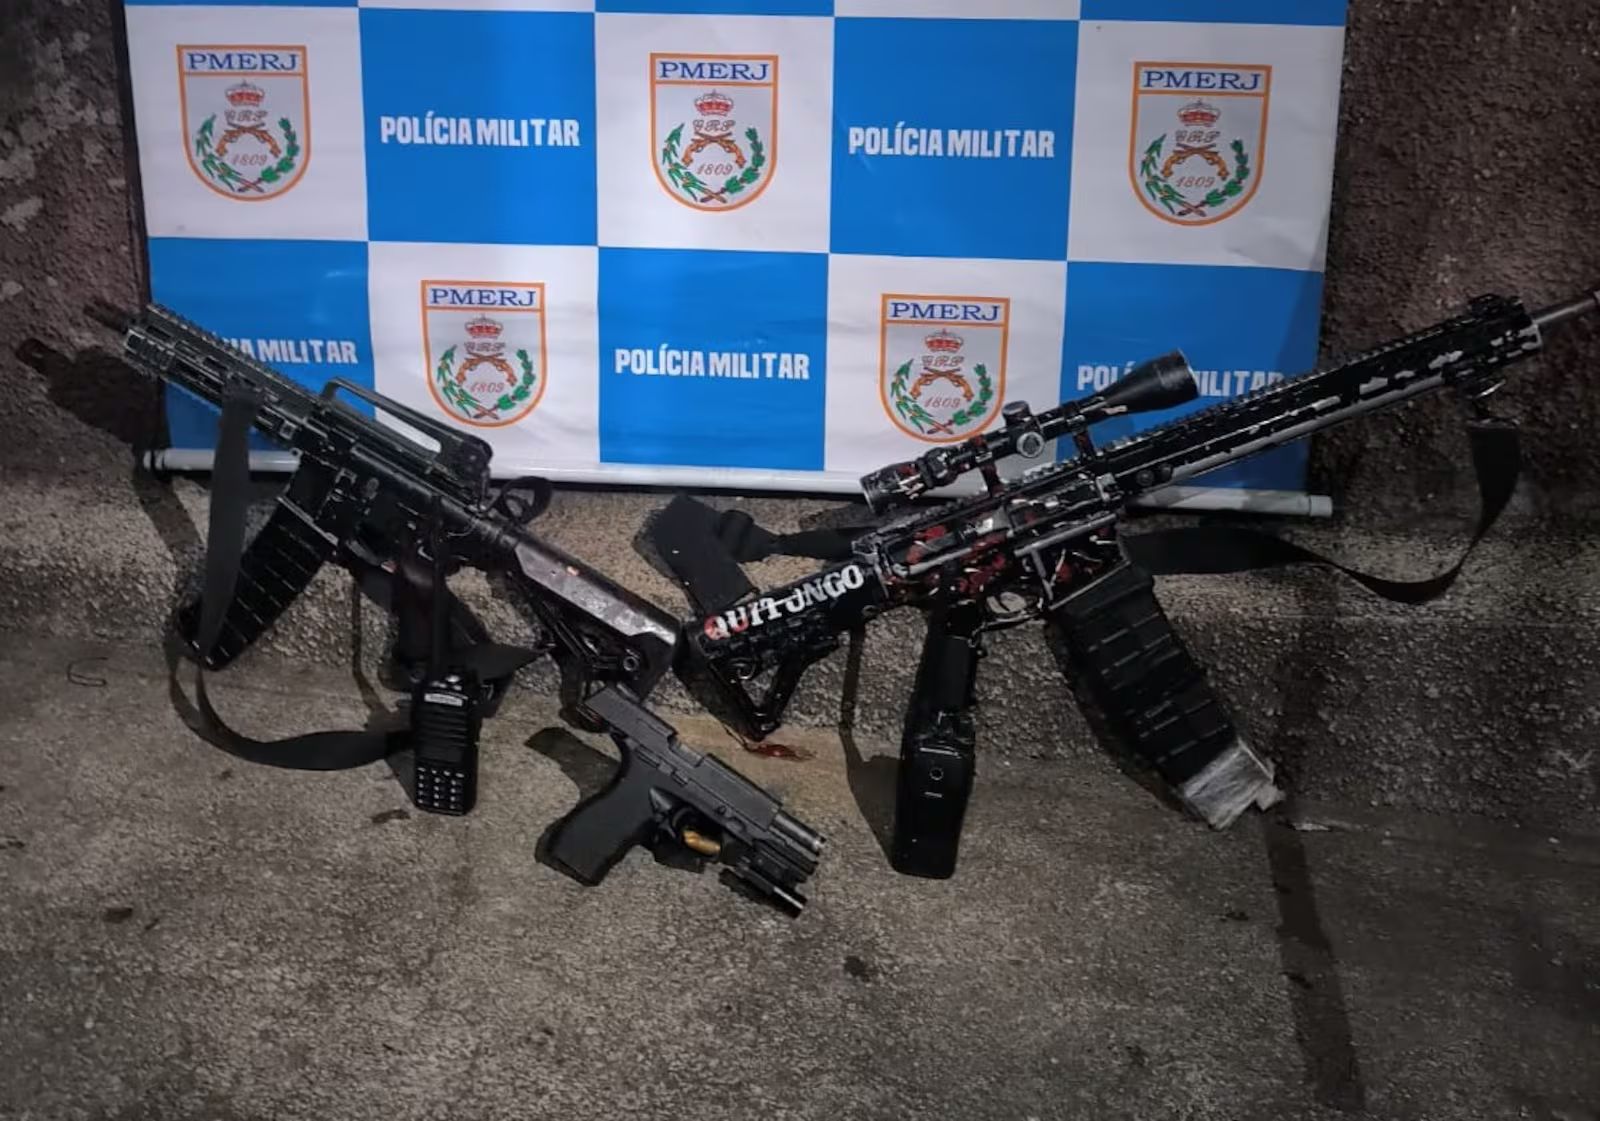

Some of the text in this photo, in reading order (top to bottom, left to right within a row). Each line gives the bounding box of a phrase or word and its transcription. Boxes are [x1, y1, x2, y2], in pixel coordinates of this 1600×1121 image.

[188, 53, 298, 71] PMERJ
[660, 61, 769, 81] PMERJ
[1144, 70, 1261, 91] PMERJ
[380, 111, 581, 147] POLÍCIA MILITAR
[848, 121, 1055, 158] POLÍCIA MILITAR
[231, 153, 268, 166] 1809
[697, 163, 734, 176] 1809
[1176, 175, 1216, 188] 1809
[430, 288, 537, 307] PMERJ
[890, 302, 1001, 321] PMERJ
[256, 338, 358, 364] MILITAR
[614, 343, 810, 380] POLÍCIA MILITAR
[470, 382, 505, 393] 1809
[924, 396, 961, 409] 1809
